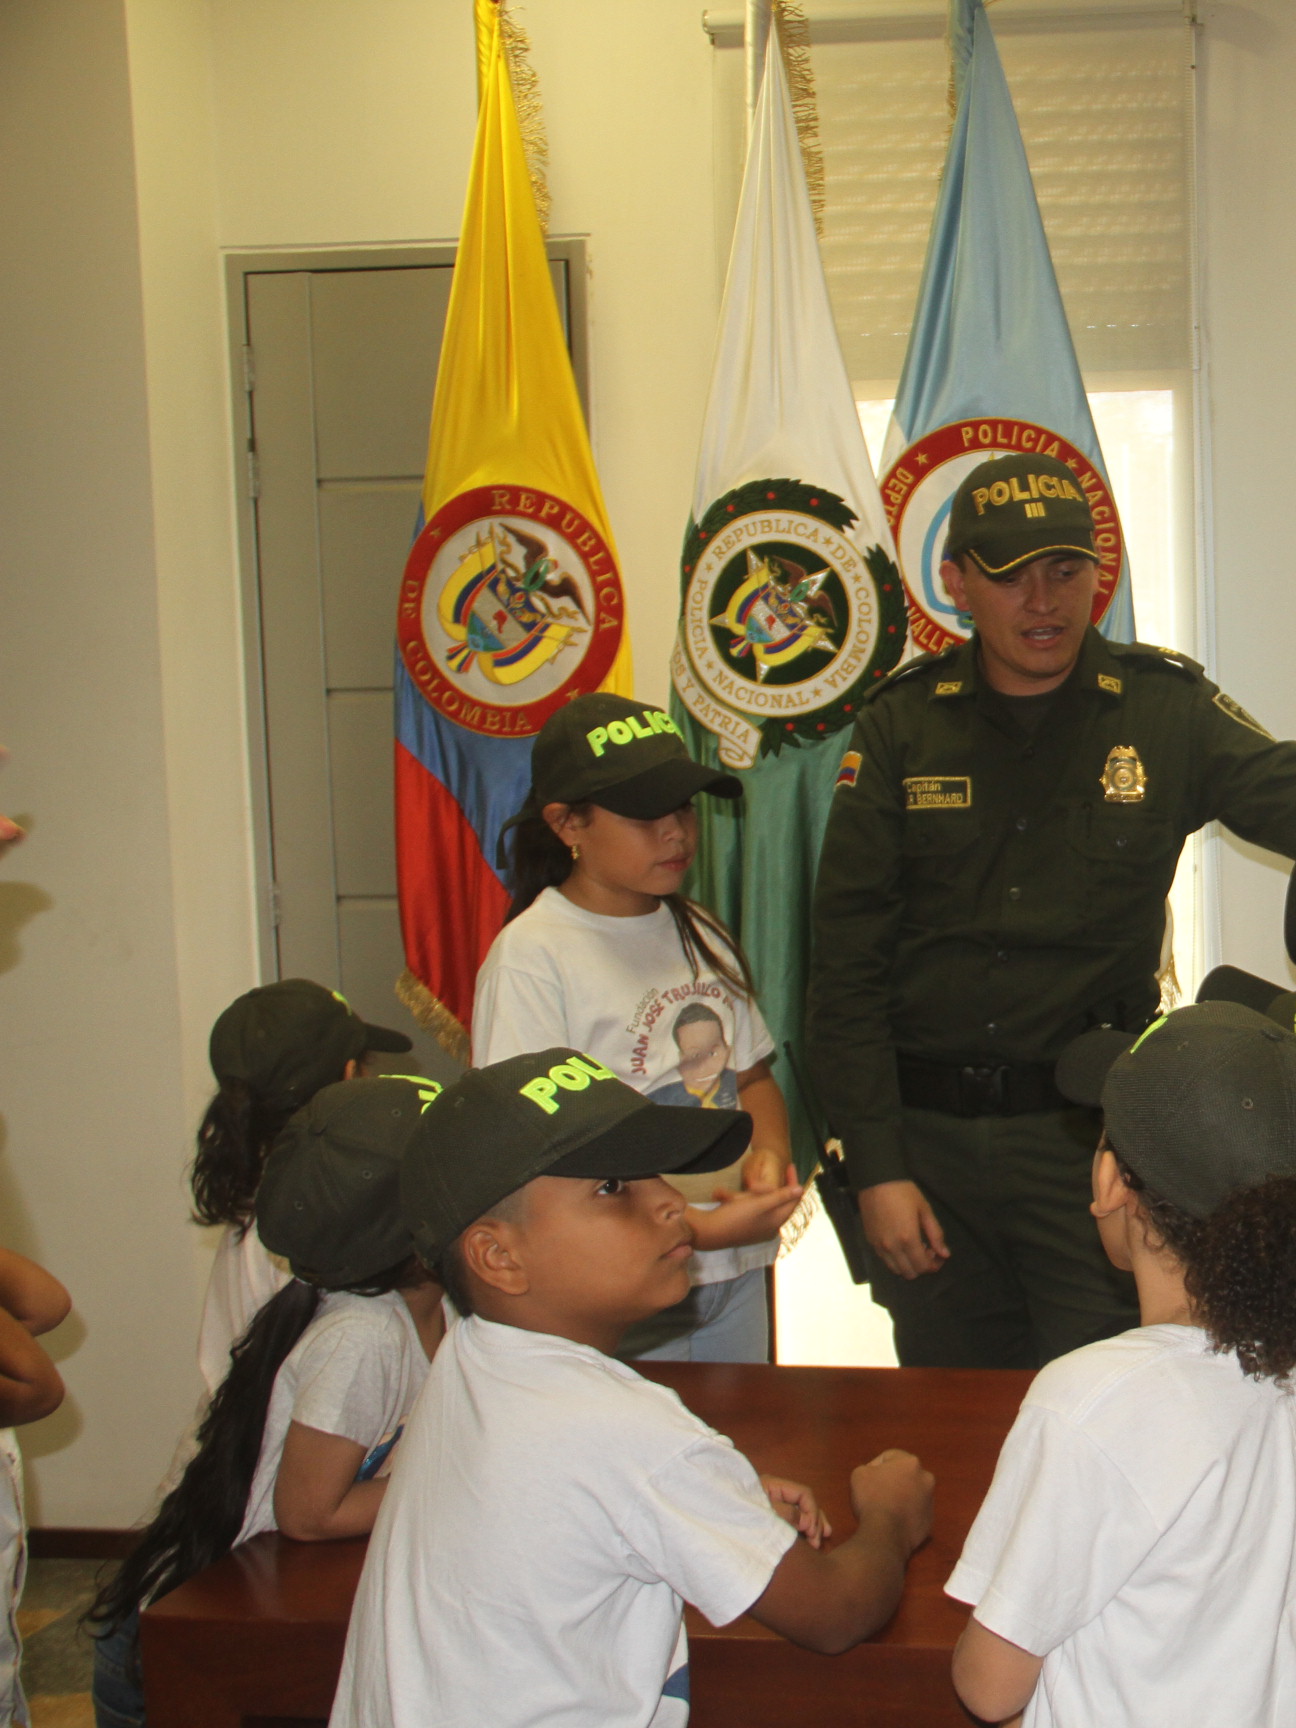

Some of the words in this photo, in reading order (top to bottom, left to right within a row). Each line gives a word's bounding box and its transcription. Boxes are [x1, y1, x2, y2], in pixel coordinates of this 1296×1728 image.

[961, 423, 1062, 459] POLICIA
[971, 473, 1084, 516] POLICIA
[490, 489, 620, 633] REPUBLICA
[712, 518, 827, 561] REPUBLICA
[829, 544, 859, 573] DE
[689, 577, 709, 660] POLICIA
[711, 669, 810, 711] NACIONAL
[822, 585, 873, 691] COLOMBIA
[405, 639, 533, 732] COLOMBIA
[692, 694, 751, 745] PATRIA
[631, 1034, 650, 1075] JUAN
